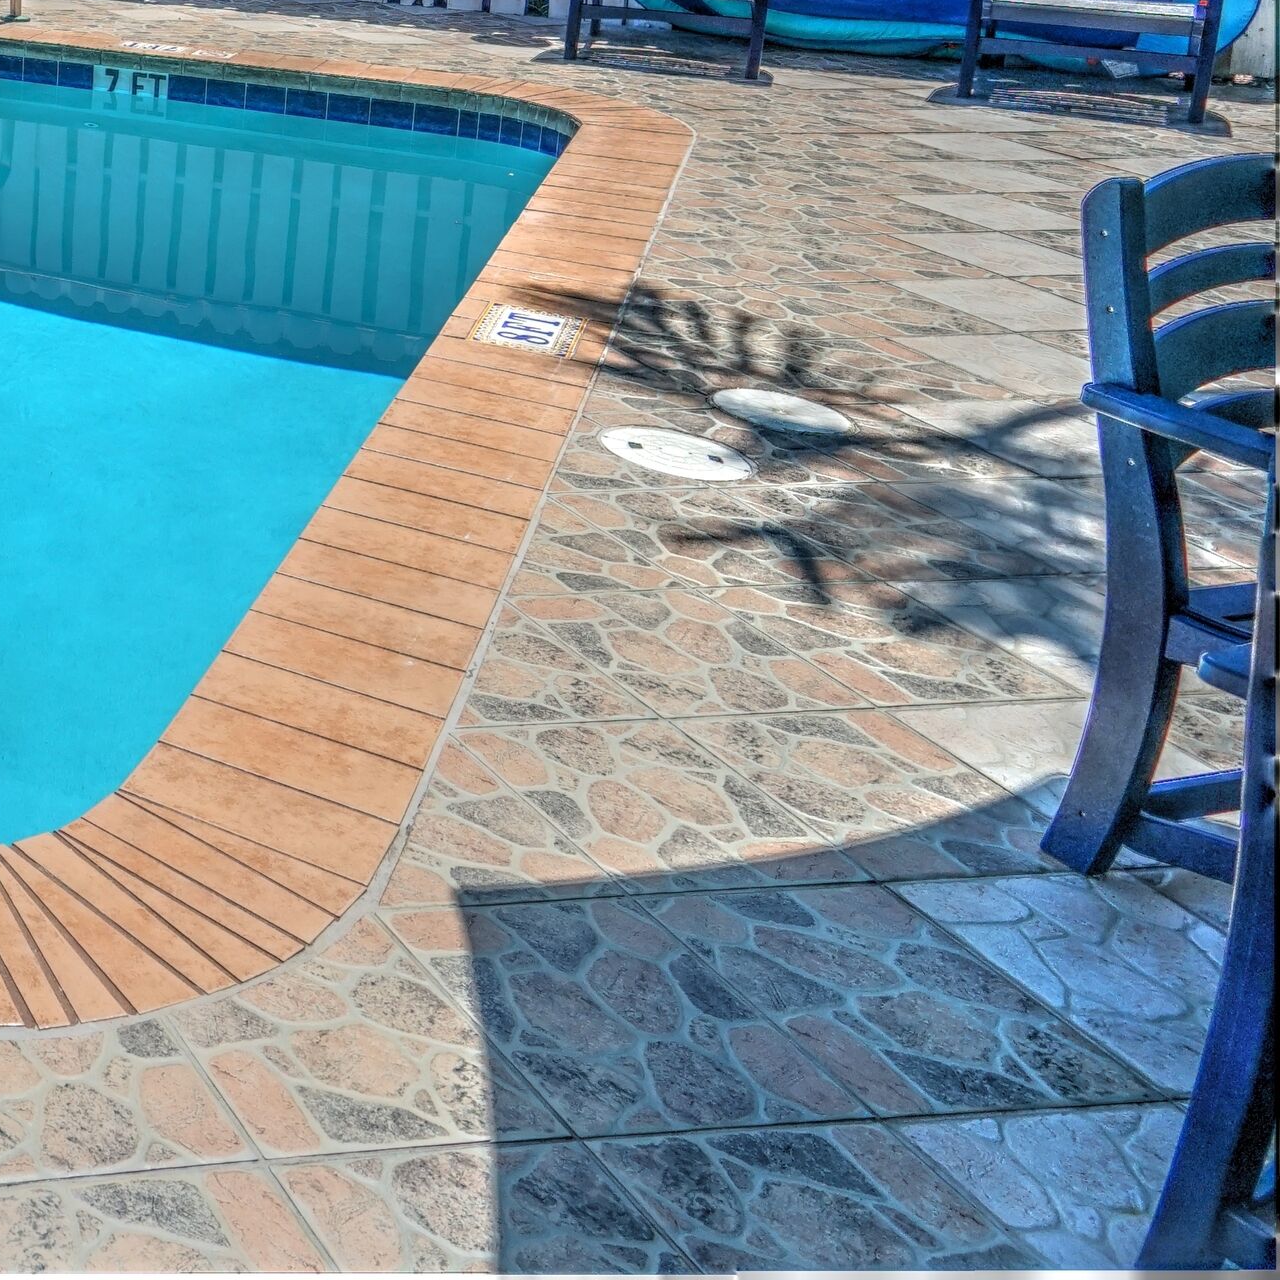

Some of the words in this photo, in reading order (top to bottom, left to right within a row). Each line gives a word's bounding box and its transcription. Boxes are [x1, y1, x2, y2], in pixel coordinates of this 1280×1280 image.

[105, 68, 119, 92] 7
[132, 72, 167, 98] FT
[496, 312, 560, 345] 8FT
